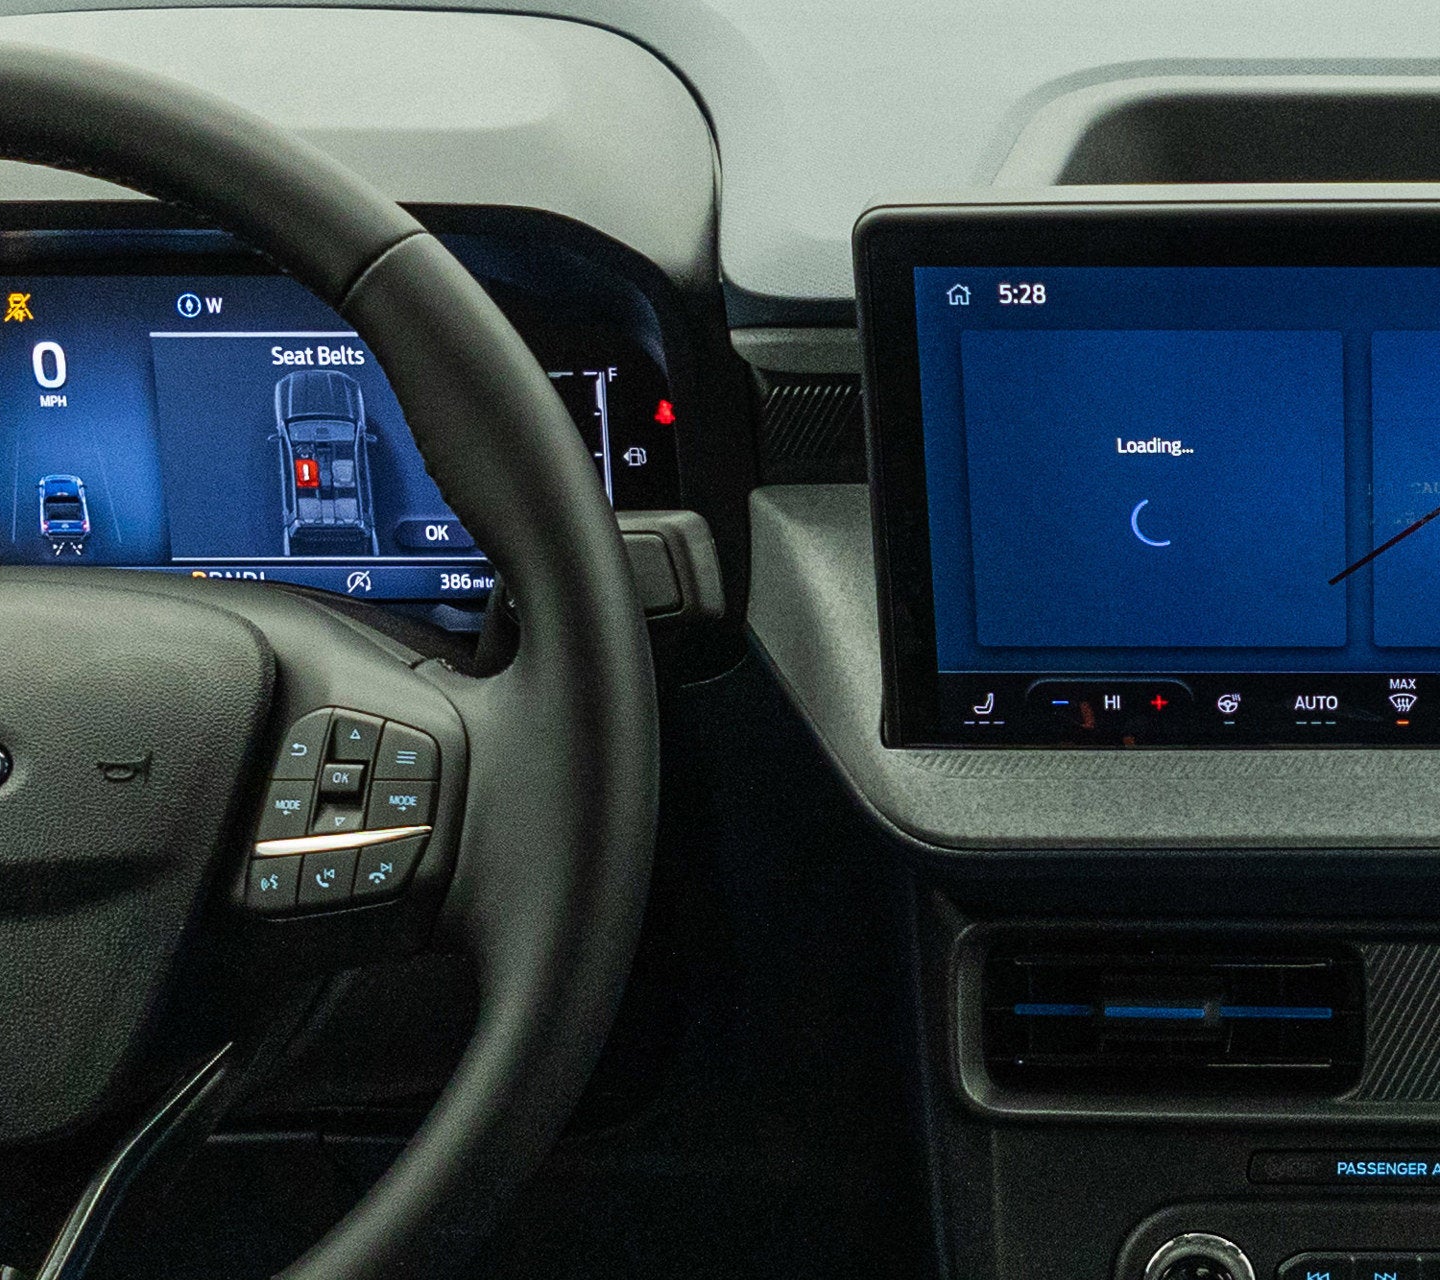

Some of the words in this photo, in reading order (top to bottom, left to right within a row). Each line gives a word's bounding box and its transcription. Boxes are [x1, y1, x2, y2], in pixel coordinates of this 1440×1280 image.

[998, 284, 1046, 304] 5:28
[205, 297, 222, 313] W
[271, 346, 313, 365] Seat
[317, 345, 365, 365] Belts
[32, 341, 67, 389] 0
[607, 367, 618, 383] F
[40, 395, 67, 408] MPH
[1116, 437, 1194, 456] Loading...
[425, 524, 449, 541] OK
[440, 573, 472, 589] 386
[1389, 678, 1417, 690] MAX
[1104, 694, 1121, 710] HI
[1294, 695, 1338, 711] AUTO
[332, 771, 349, 784] OK
[274, 799, 301, 811] MODE
[388, 794, 417, 807] MODE
[1337, 1162, 1427, 1175] PASSENGER
